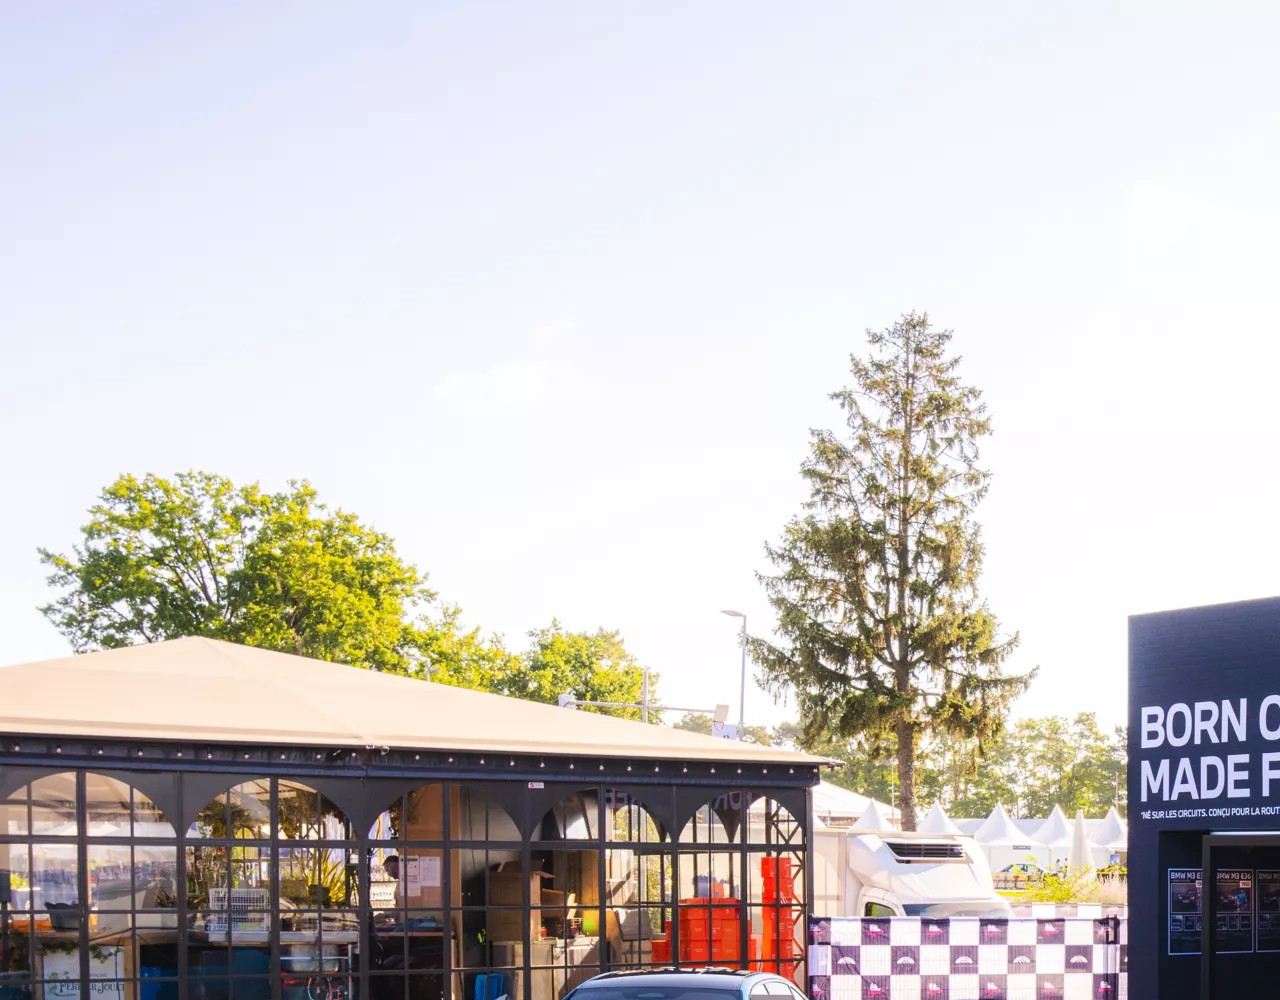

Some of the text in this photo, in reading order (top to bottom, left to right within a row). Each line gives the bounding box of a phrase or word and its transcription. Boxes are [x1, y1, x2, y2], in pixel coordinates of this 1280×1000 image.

[1141, 698, 1248, 749] BORN
[1141, 754, 1251, 803] MADE
[1152, 810, 1165, 819] SUR
[1165, 809, 1177, 818] LES
[1178, 808, 1208, 818] CIRCUITS.
[1208, 807, 1231, 818] CONÇU
[1231, 807, 1250, 816] POUR
[1251, 806, 1261, 816] LA
[1170, 872, 1186, 880] BMW
